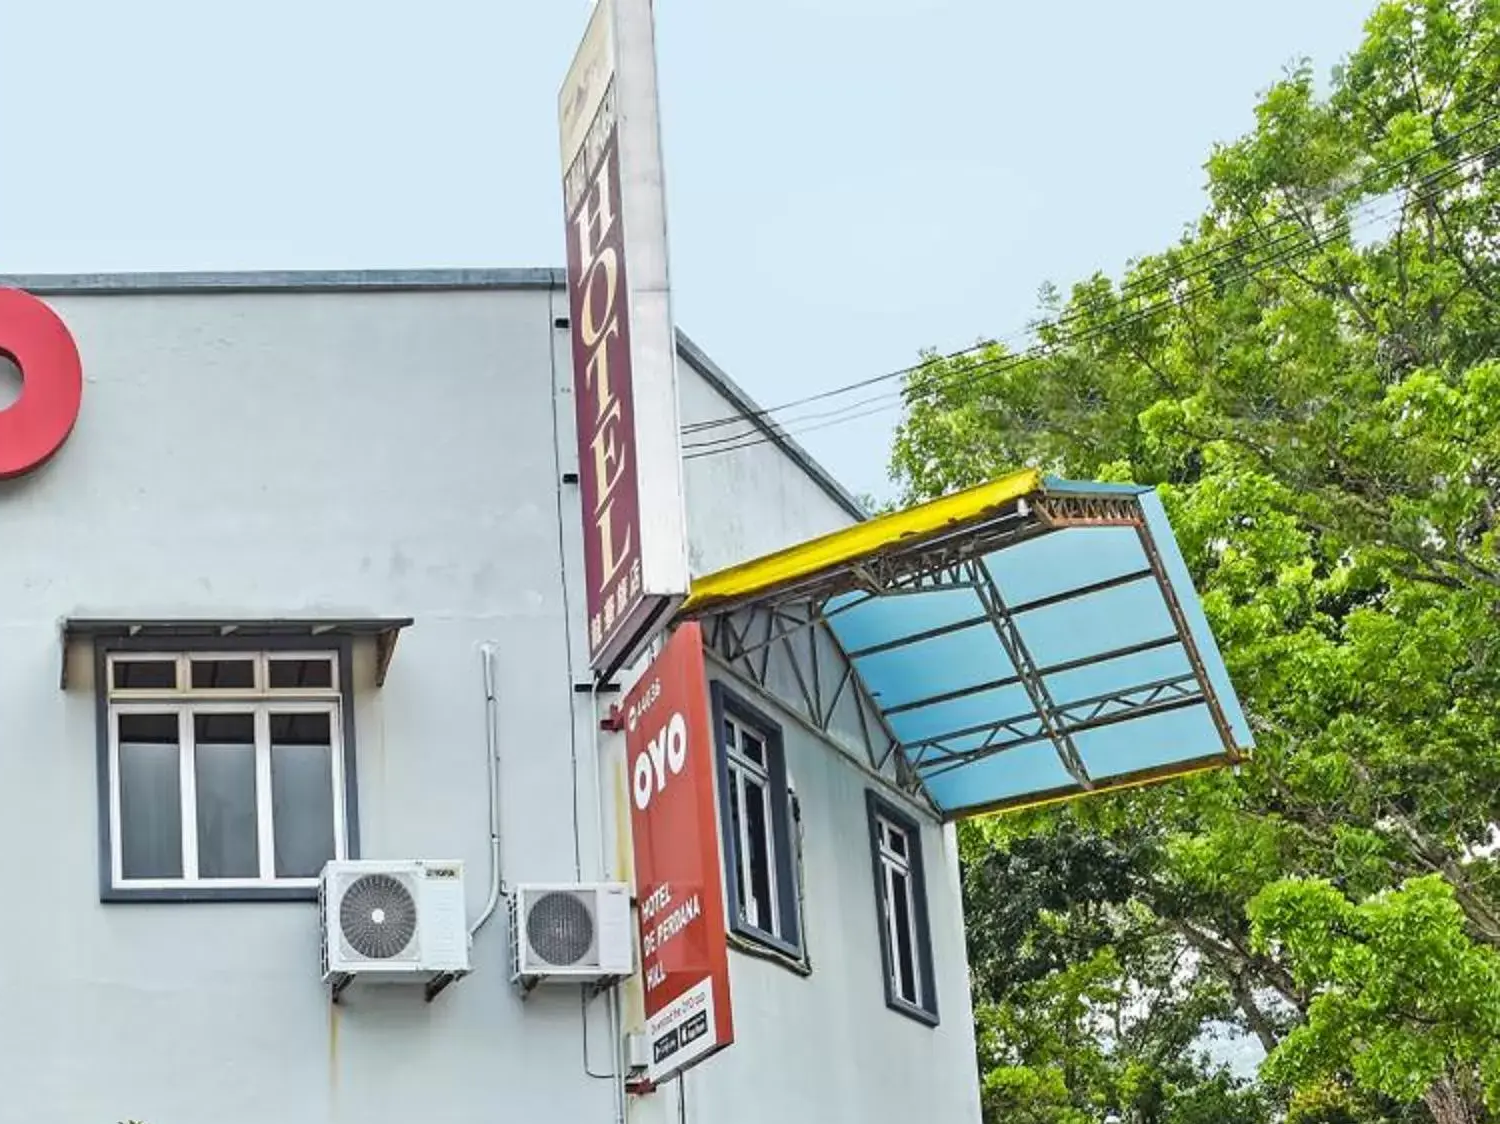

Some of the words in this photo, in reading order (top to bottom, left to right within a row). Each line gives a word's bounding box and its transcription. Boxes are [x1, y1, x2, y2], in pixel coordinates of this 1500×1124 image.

[574, 148, 632, 594] HOTEL
[633, 711, 687, 811] OYO
[642, 881, 671, 923] HOTEL
[644, 929, 656, 957] DE
